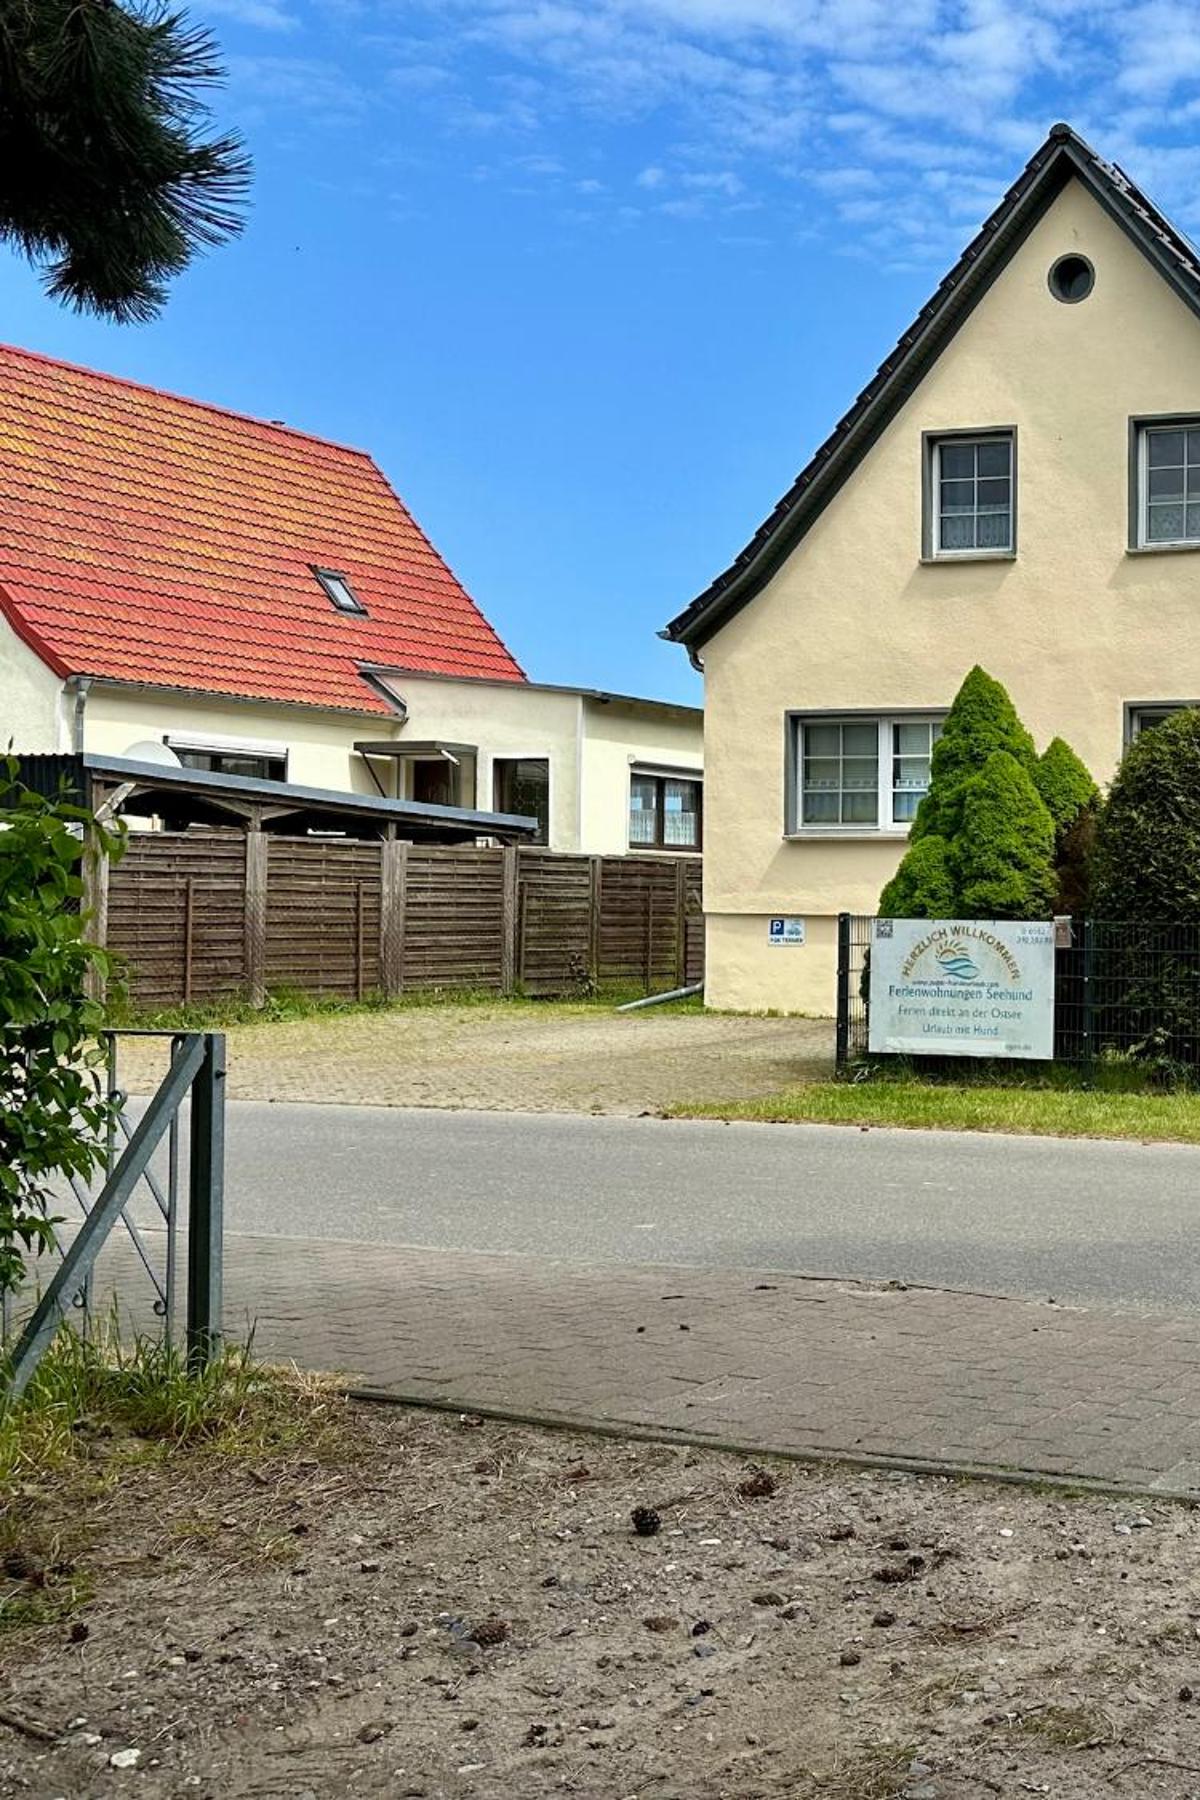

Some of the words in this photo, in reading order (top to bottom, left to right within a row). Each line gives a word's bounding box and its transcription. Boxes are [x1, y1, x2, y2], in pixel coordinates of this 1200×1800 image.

[772, 921, 782, 933] P
[902, 928, 948, 977] HERZLICH
[950, 925, 1020, 980] WILLKOMMEN
[889, 985, 983, 1000] Ferienwohnungen
[986, 988, 1032, 1000] Seehund
[898, 1004, 925, 1017] Ferien
[929, 1006, 957, 1017] direkt
[959, 1009, 969, 1018] an
[972, 1007, 987, 1018] der
[991, 1008, 1022, 1019] Ostsee
[922, 1023, 952, 1034] Urlaub
[955, 1026, 970, 1034] mit
[974, 1025, 998, 1036] Hund
